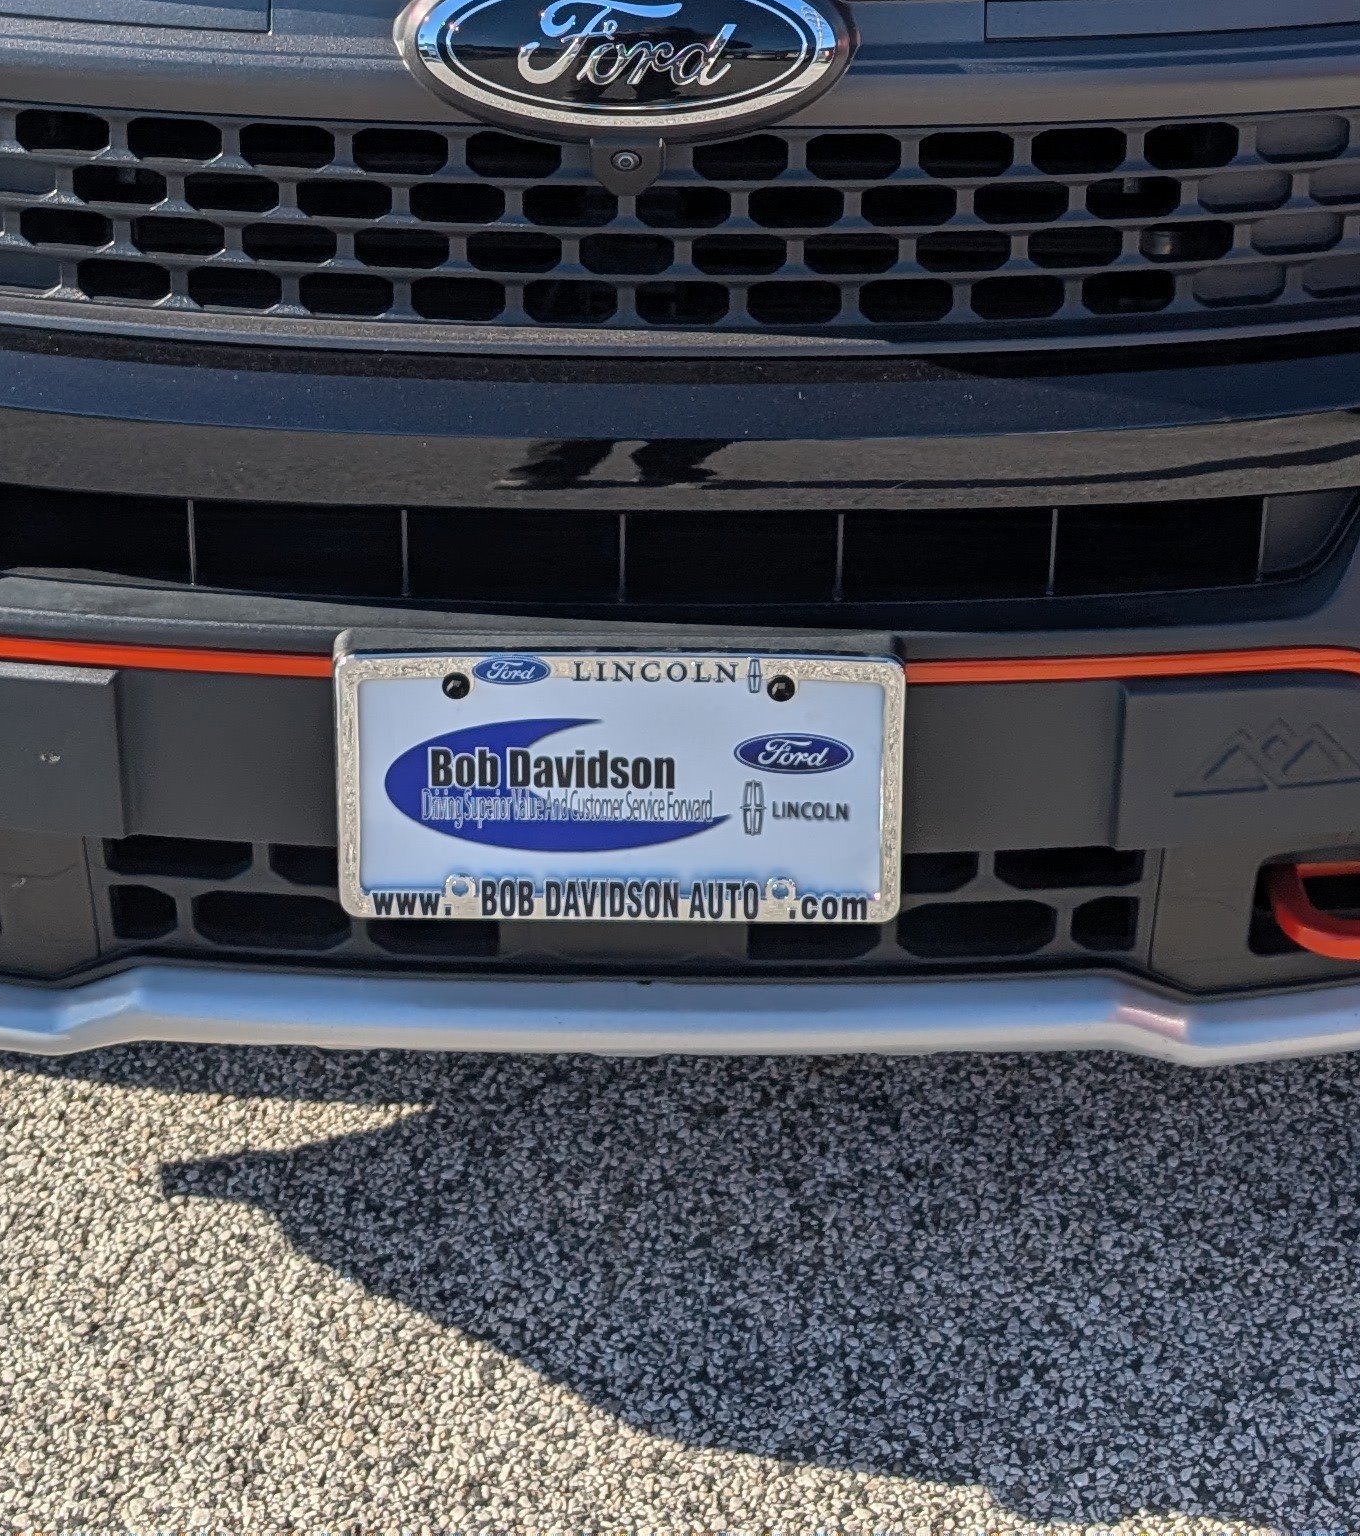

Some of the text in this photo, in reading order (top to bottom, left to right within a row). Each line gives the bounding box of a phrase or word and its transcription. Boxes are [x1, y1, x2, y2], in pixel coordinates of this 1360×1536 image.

[486, 660, 738, 682] Ford LINCOLN
[429, 748, 675, 789] Bob Davidson
[757, 738, 830, 767] Ford
[422, 789, 713, 828] Driving Superior Value And Customer Service Forward
[772, 800, 849, 821] LINCOLN
[481, 880, 534, 917] BOB
[545, 880, 680, 918] DAVIDSON
[690, 881, 760, 920] AUTO
